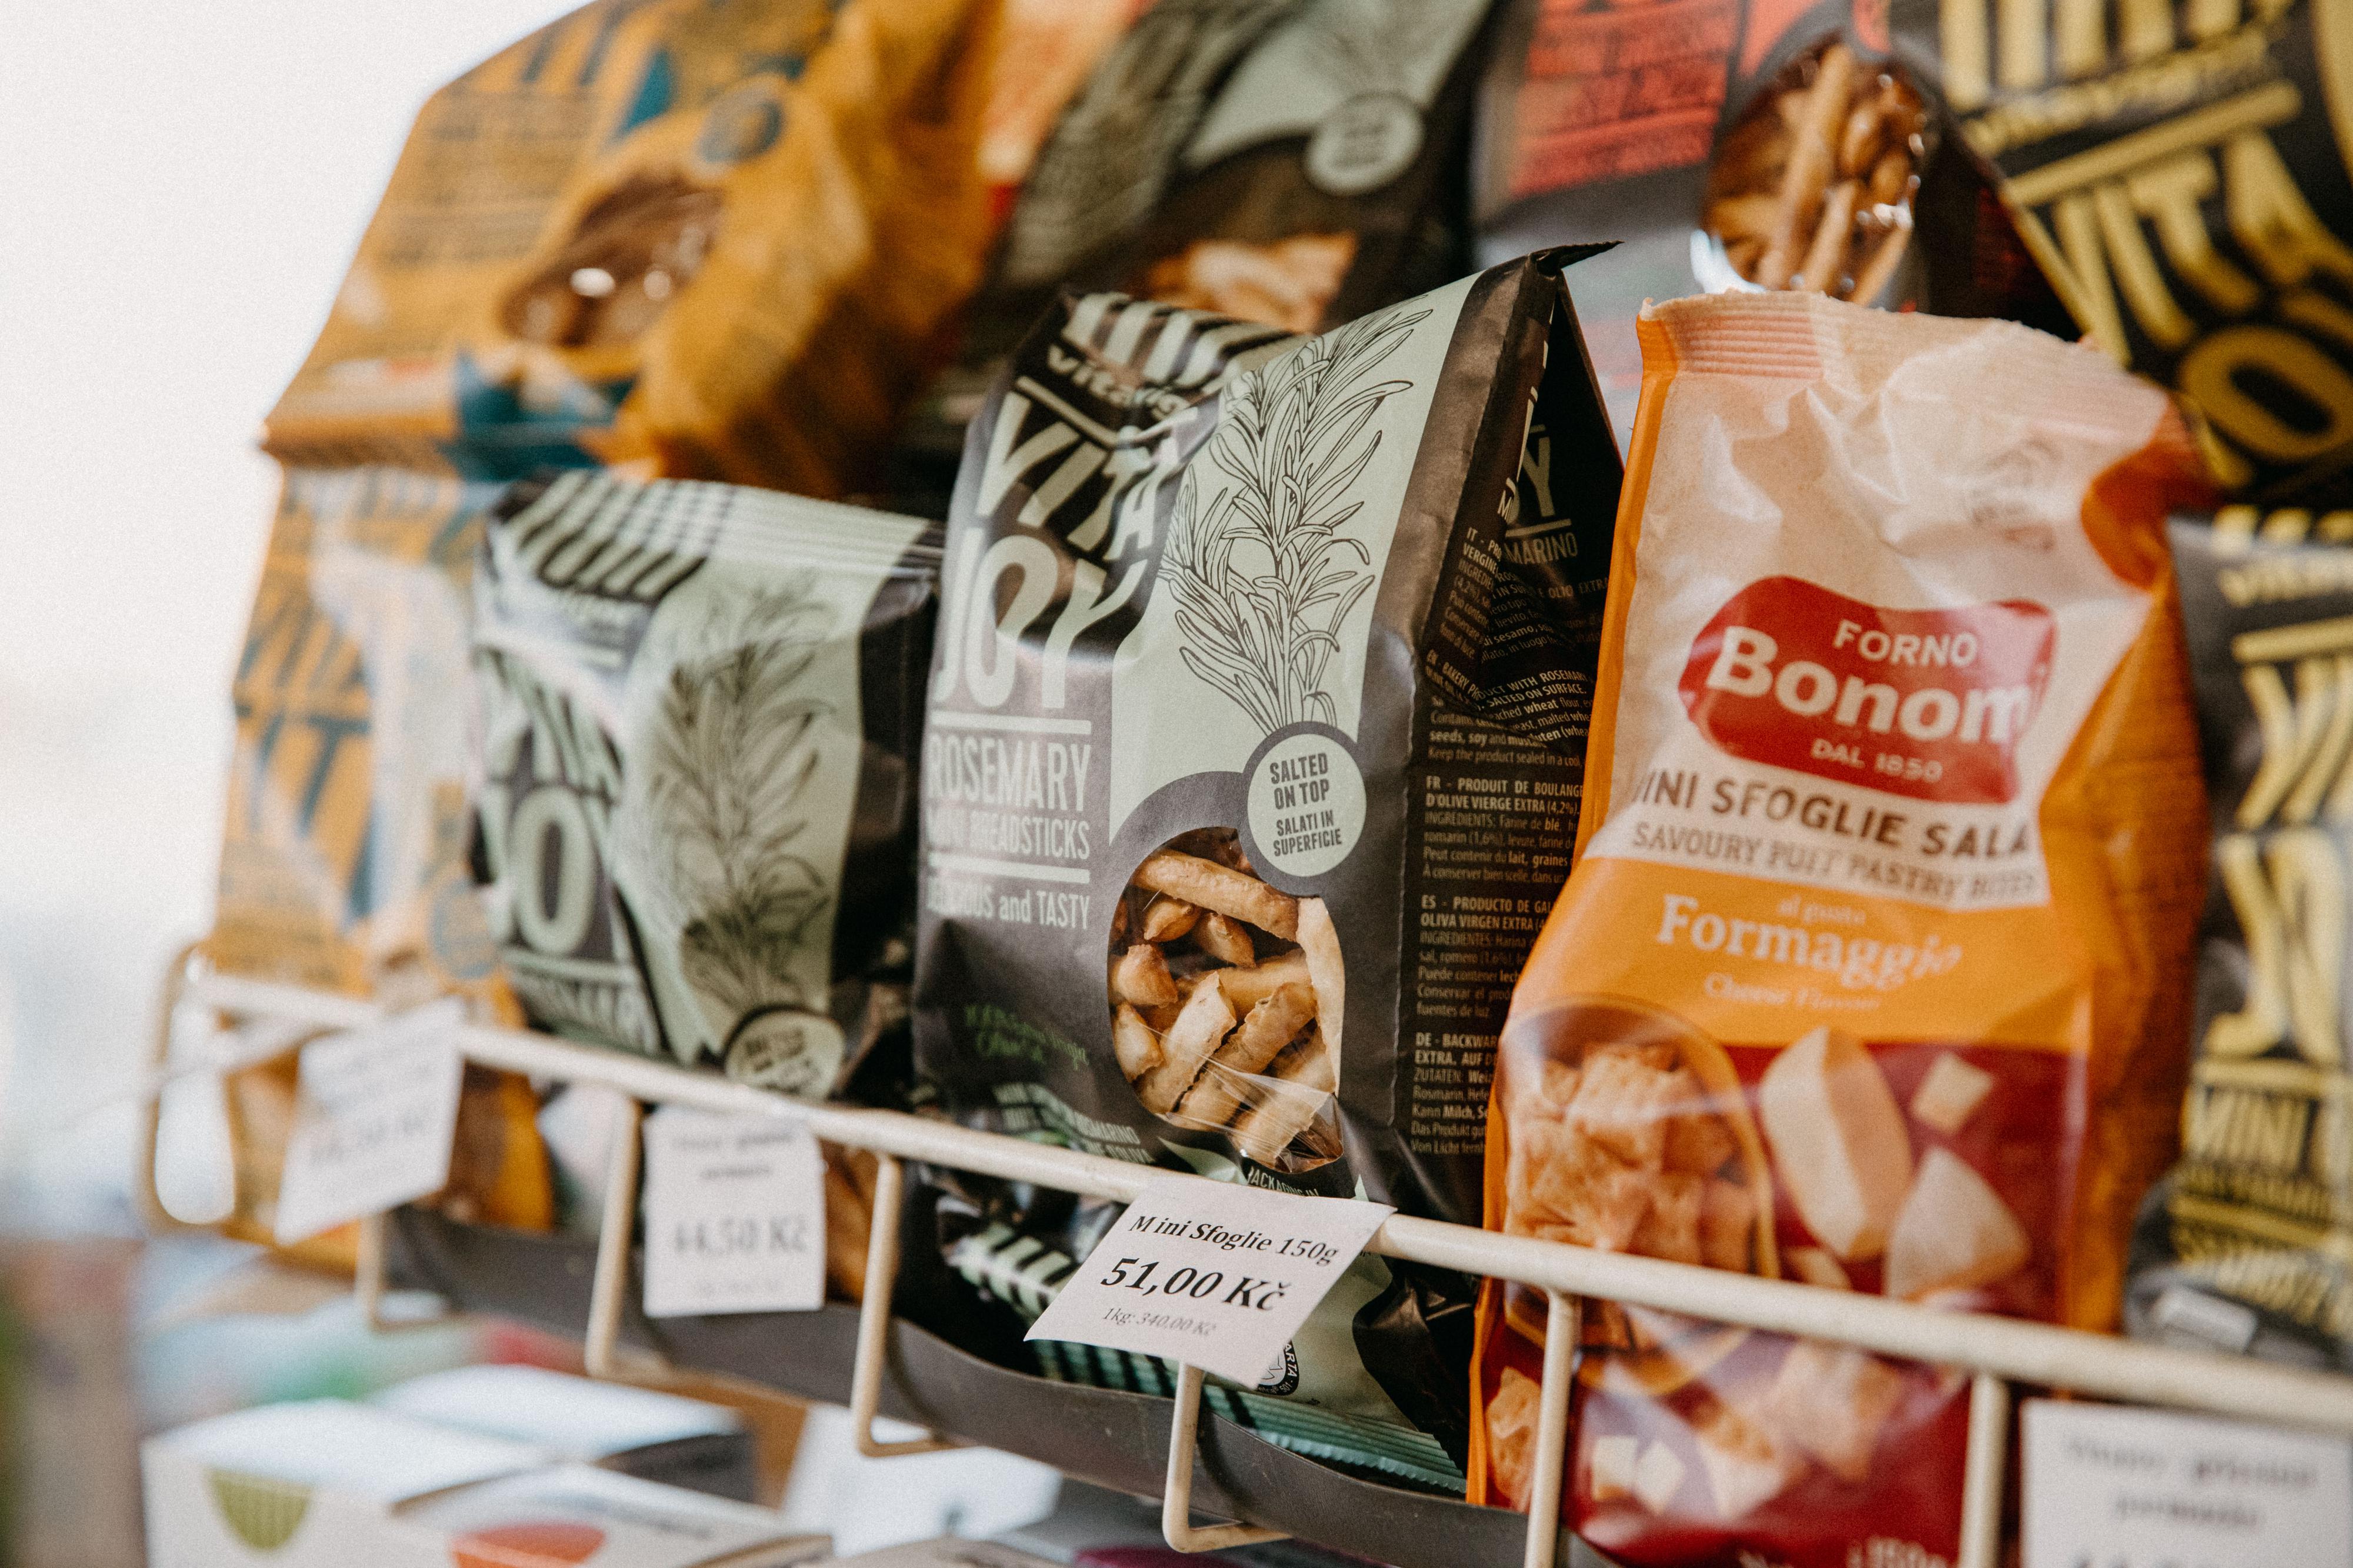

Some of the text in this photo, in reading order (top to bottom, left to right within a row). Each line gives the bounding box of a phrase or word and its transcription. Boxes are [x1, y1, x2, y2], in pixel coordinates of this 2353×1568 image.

[1467, 527, 1478, 542] IT
[1494, 624, 1538, 644] sesamo,
[1834, 618, 1977, 668] FORNO
[1442, 661, 1470, 690] BAKERY
[1507, 676, 1538, 692] WITH
[1707, 625, 2034, 743] Bonom
[1487, 683, 1587, 708] SALTED ON SURFACE.
[1524, 699, 1559, 715] wheat
[1537, 711, 1571, 727] malted
[1468, 732, 1488, 748] soy
[1269, 752, 1328, 784] SALTED
[1475, 750, 1514, 764] product
[1809, 738, 1946, 783] DAL 1850
[1274, 779, 1329, 809] ON TOP
[1426, 775, 1441, 791] FR
[1458, 777, 1508, 794] PRODUIT
[1514, 779, 1529, 795] DE
[1425, 792, 1470, 809] D'OLIVE
[1471, 795, 1512, 812] VIERGE
[1514, 797, 1546, 813] EXTRA
[1711, 778, 1907, 848] SFOGLIE
[1276, 809, 1334, 836] SALATI IN
[1273, 829, 1342, 857] SUPERFICIE
[1532, 852, 1569, 869] graines
[1630, 822, 1762, 868] SAVOURY
[1847, 853, 1957, 899] PASTRY
[999, 889, 1031, 923] and
[1036, 890, 1089, 930] TASTY
[1421, 894, 1437, 909] ES
[1452, 896, 1513, 913] PRODUCTO
[1517, 899, 1529, 913] DE
[1420, 912, 1534, 931] OLIVA VIRGEN EXTRA
[1656, 893, 1964, 989] Formaggio
[1415, 1032, 1432, 1047] DE
[1414, 1049, 1484, 1067] EXTRA. AUF
[1128, 1215, 1192, 1236] Mini
[1189, 1223, 1272, 1251] Sfoglie
[1274, 1237, 1339, 1266] 150g
[1100, 1257, 1291, 1313] 51,00 Kč
[1102, 1307, 1136, 1326] 1kg:
